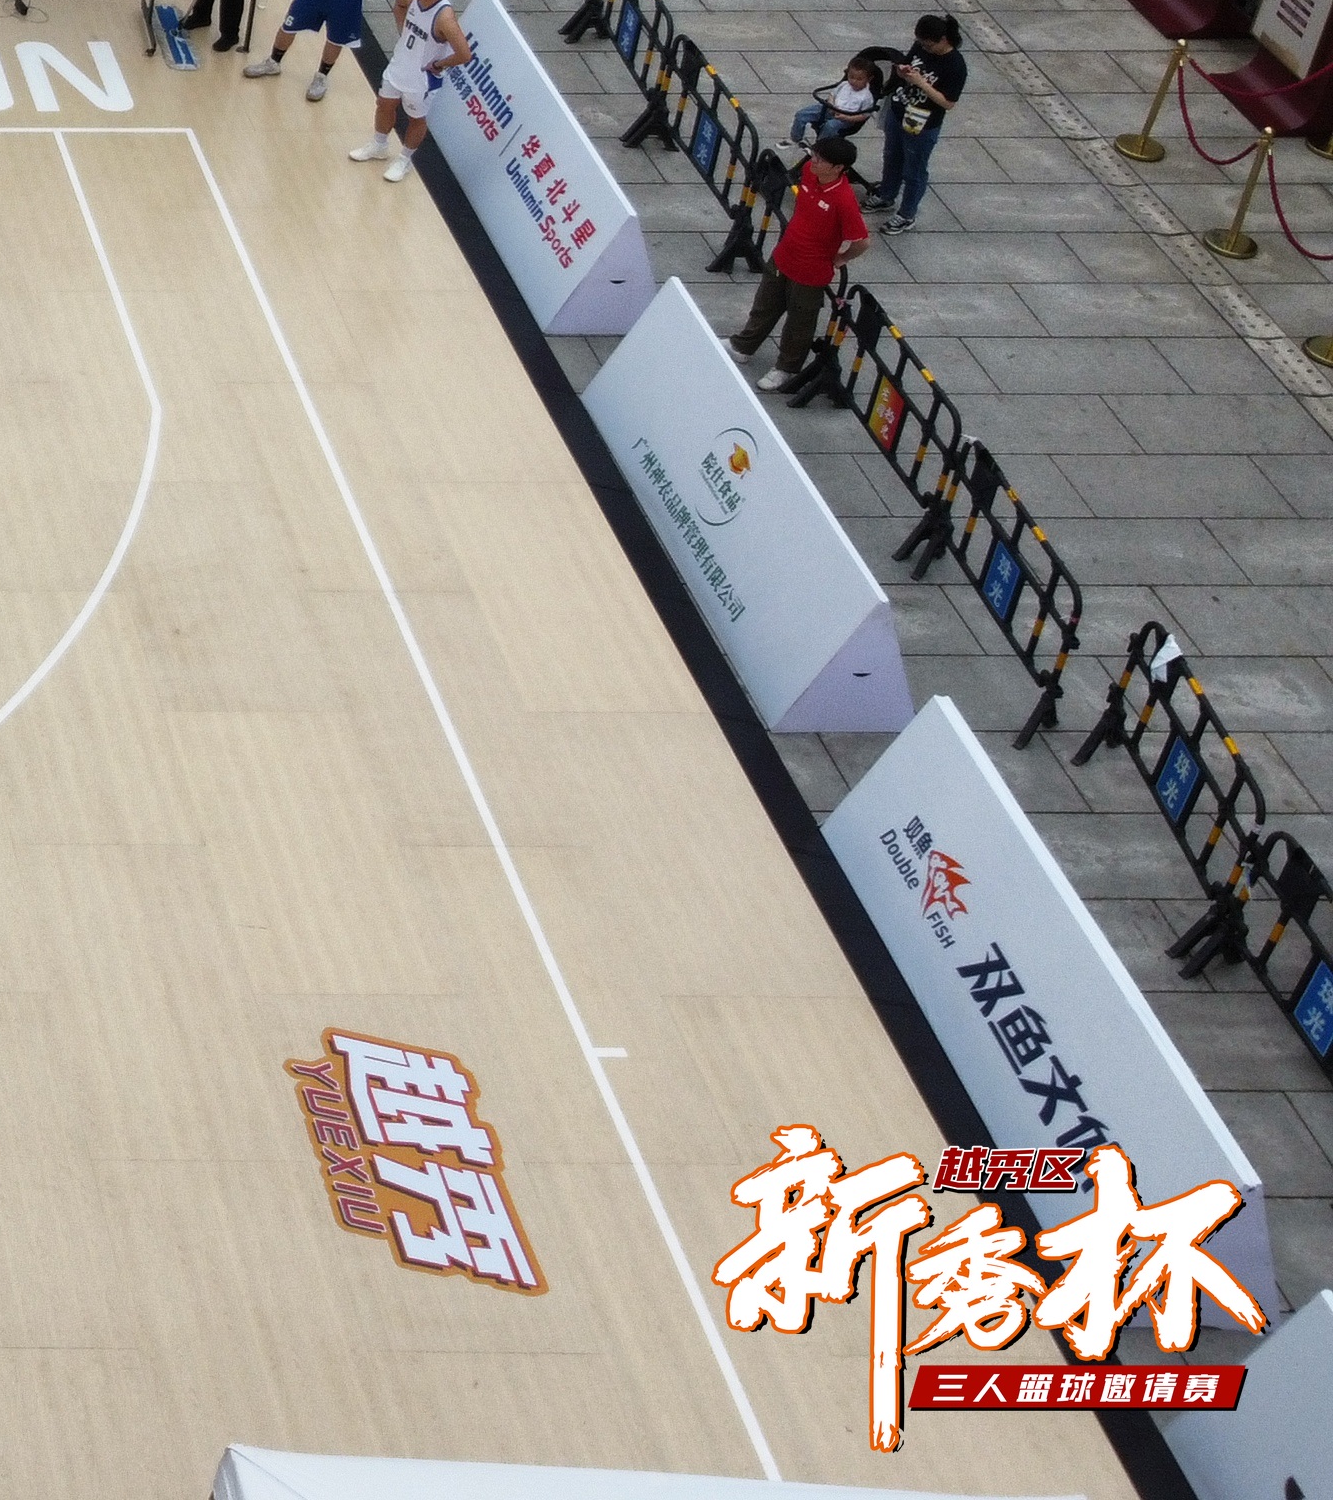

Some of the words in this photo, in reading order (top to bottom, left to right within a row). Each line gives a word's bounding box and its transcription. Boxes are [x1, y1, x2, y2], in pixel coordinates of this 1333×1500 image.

[701, 451, 741, 513] 院仕食品
[631, 436, 746, 623] 广州神农品牌管理有限公司
[988, 553, 1012, 608] 珠光
[1162, 750, 1191, 809] 珠光
[879, 828, 920, 890] Double
[926, 911, 956, 950] FISH
[292, 1061, 387, 1233] YUEXIU
[330, 1033, 537, 1288] 越秀
